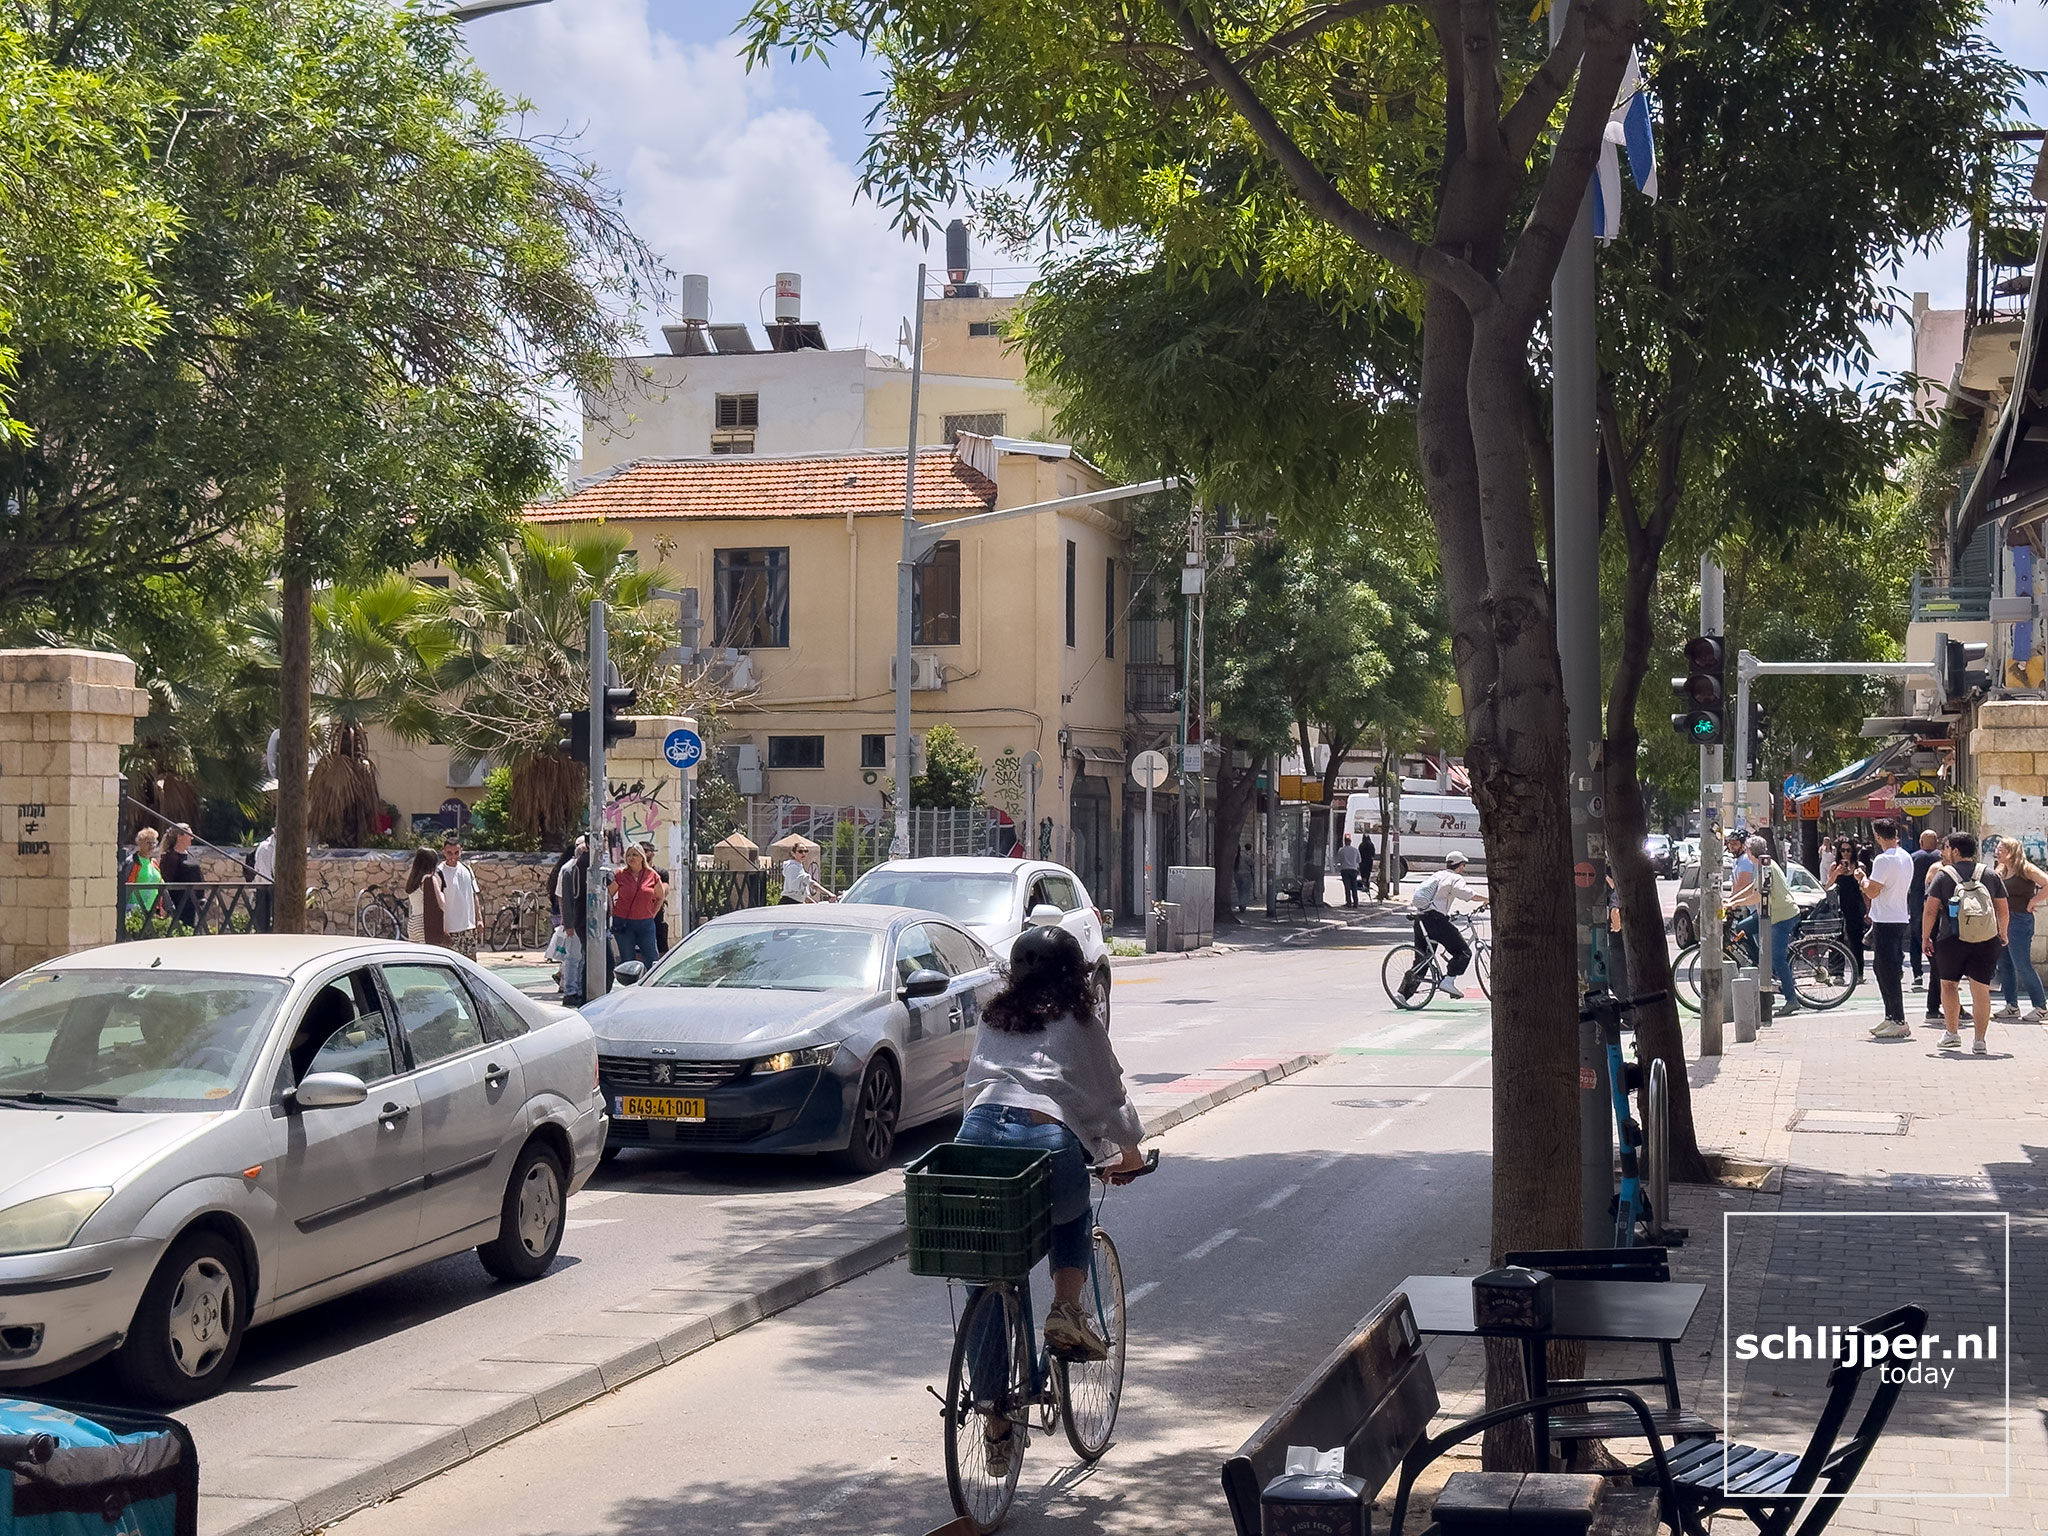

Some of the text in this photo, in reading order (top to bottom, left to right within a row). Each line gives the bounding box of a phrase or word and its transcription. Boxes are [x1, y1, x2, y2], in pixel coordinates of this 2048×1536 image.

[1895, 797, 1940, 807] STORY SHOP
[1434, 814, 1467, 830] Rafi
[1292, 1521, 1310, 1533] FAST
